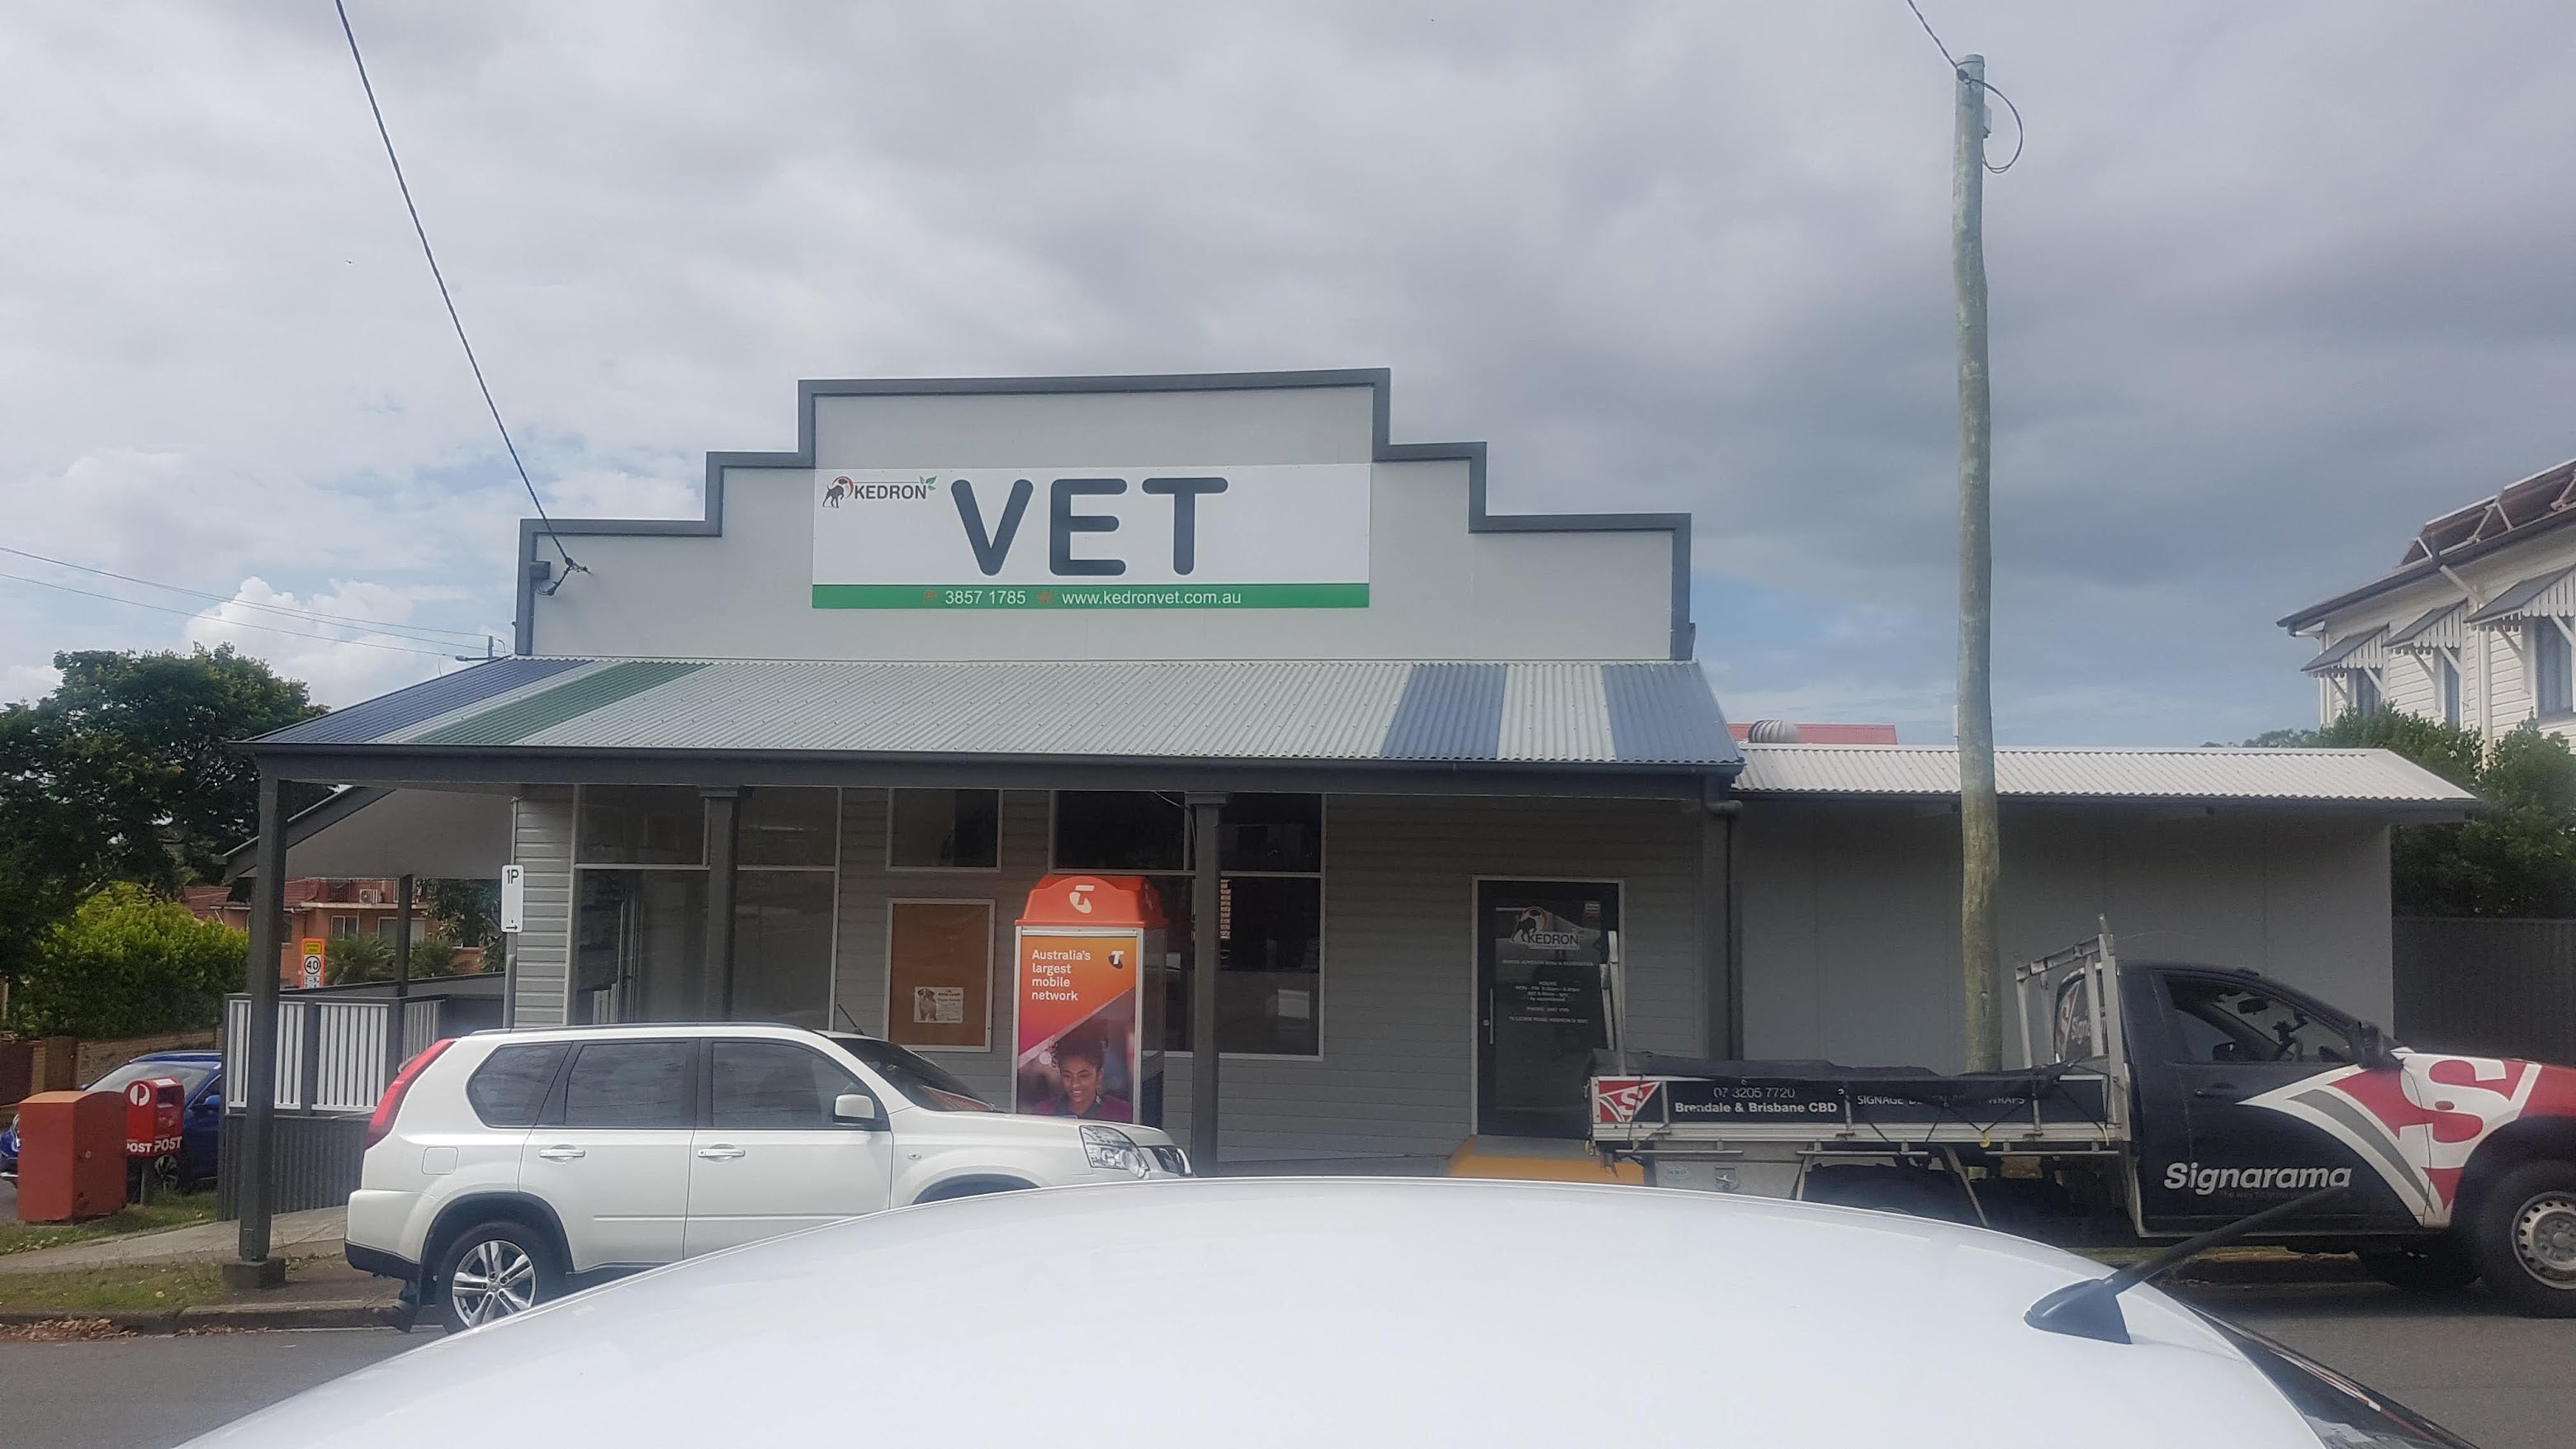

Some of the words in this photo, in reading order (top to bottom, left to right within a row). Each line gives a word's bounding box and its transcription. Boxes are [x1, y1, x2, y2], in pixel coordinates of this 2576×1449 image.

[854, 484, 927, 500] KEDRON
[950, 476, 1229, 577] VET
[945, 590, 983, 605] 3857
[988, 590, 1026, 605] 1785
[1062, 590, 1242, 606] www.kedronvet.com.au
[506, 868, 519, 885] 1P
[1527, 934, 1579, 945] KEDRON
[1032, 949, 1091, 961] Australia's
[306, 960, 319, 970] 40
[1032, 963, 1072, 975] largest
[1032, 976, 1071, 987] mobile
[1032, 991, 1078, 1001] network
[1732, 1087, 1762, 1099] 3205
[1766, 1087, 1796, 1099] 7720
[1674, 1101, 1731, 1113] Brendale
[1735, 1102, 1744, 1113] &
[1749, 1101, 1805, 1113] Brisbane
[1809, 1101, 1838, 1113] CBD
[154, 1136, 183, 1153] POST
[2163, 1162, 2352, 1196] Signarama
